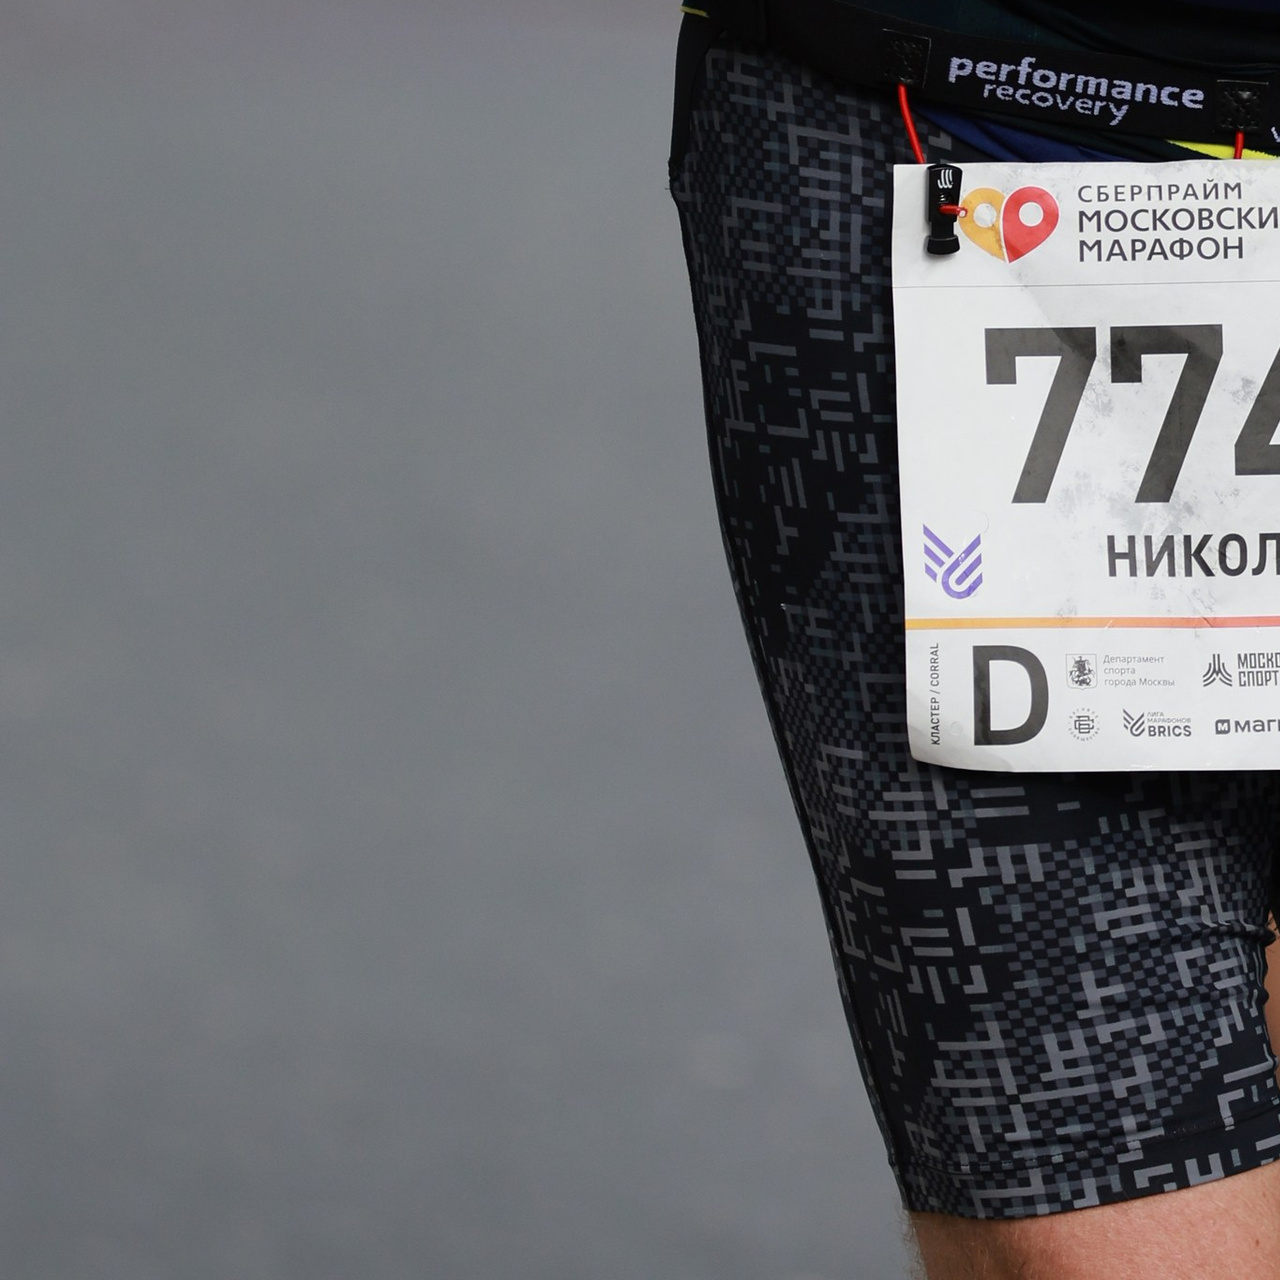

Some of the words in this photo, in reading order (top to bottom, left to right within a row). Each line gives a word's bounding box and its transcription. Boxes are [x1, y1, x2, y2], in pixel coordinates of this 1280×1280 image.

[948, 56, 1205, 109] performance
[983, 82, 1130, 126] recovery
[1077, 178, 1242, 203] СБЕРПРАЙМ
[1079, 236, 1244, 262] МАРАФОН
[929, 643, 940, 687] CORRAL
[1102, 654, 1165, 665] Департамент
[1103, 666, 1136, 677] спорта
[1104, 678, 1137, 688] города
[1138, 677, 1176, 687] Москвы
[1238, 669, 1280, 687] СПОРТ
[972, 645, 1049, 746] D
[930, 697, 941, 746] КЛАСТЕР
[1147, 725, 1193, 738] BRICS
